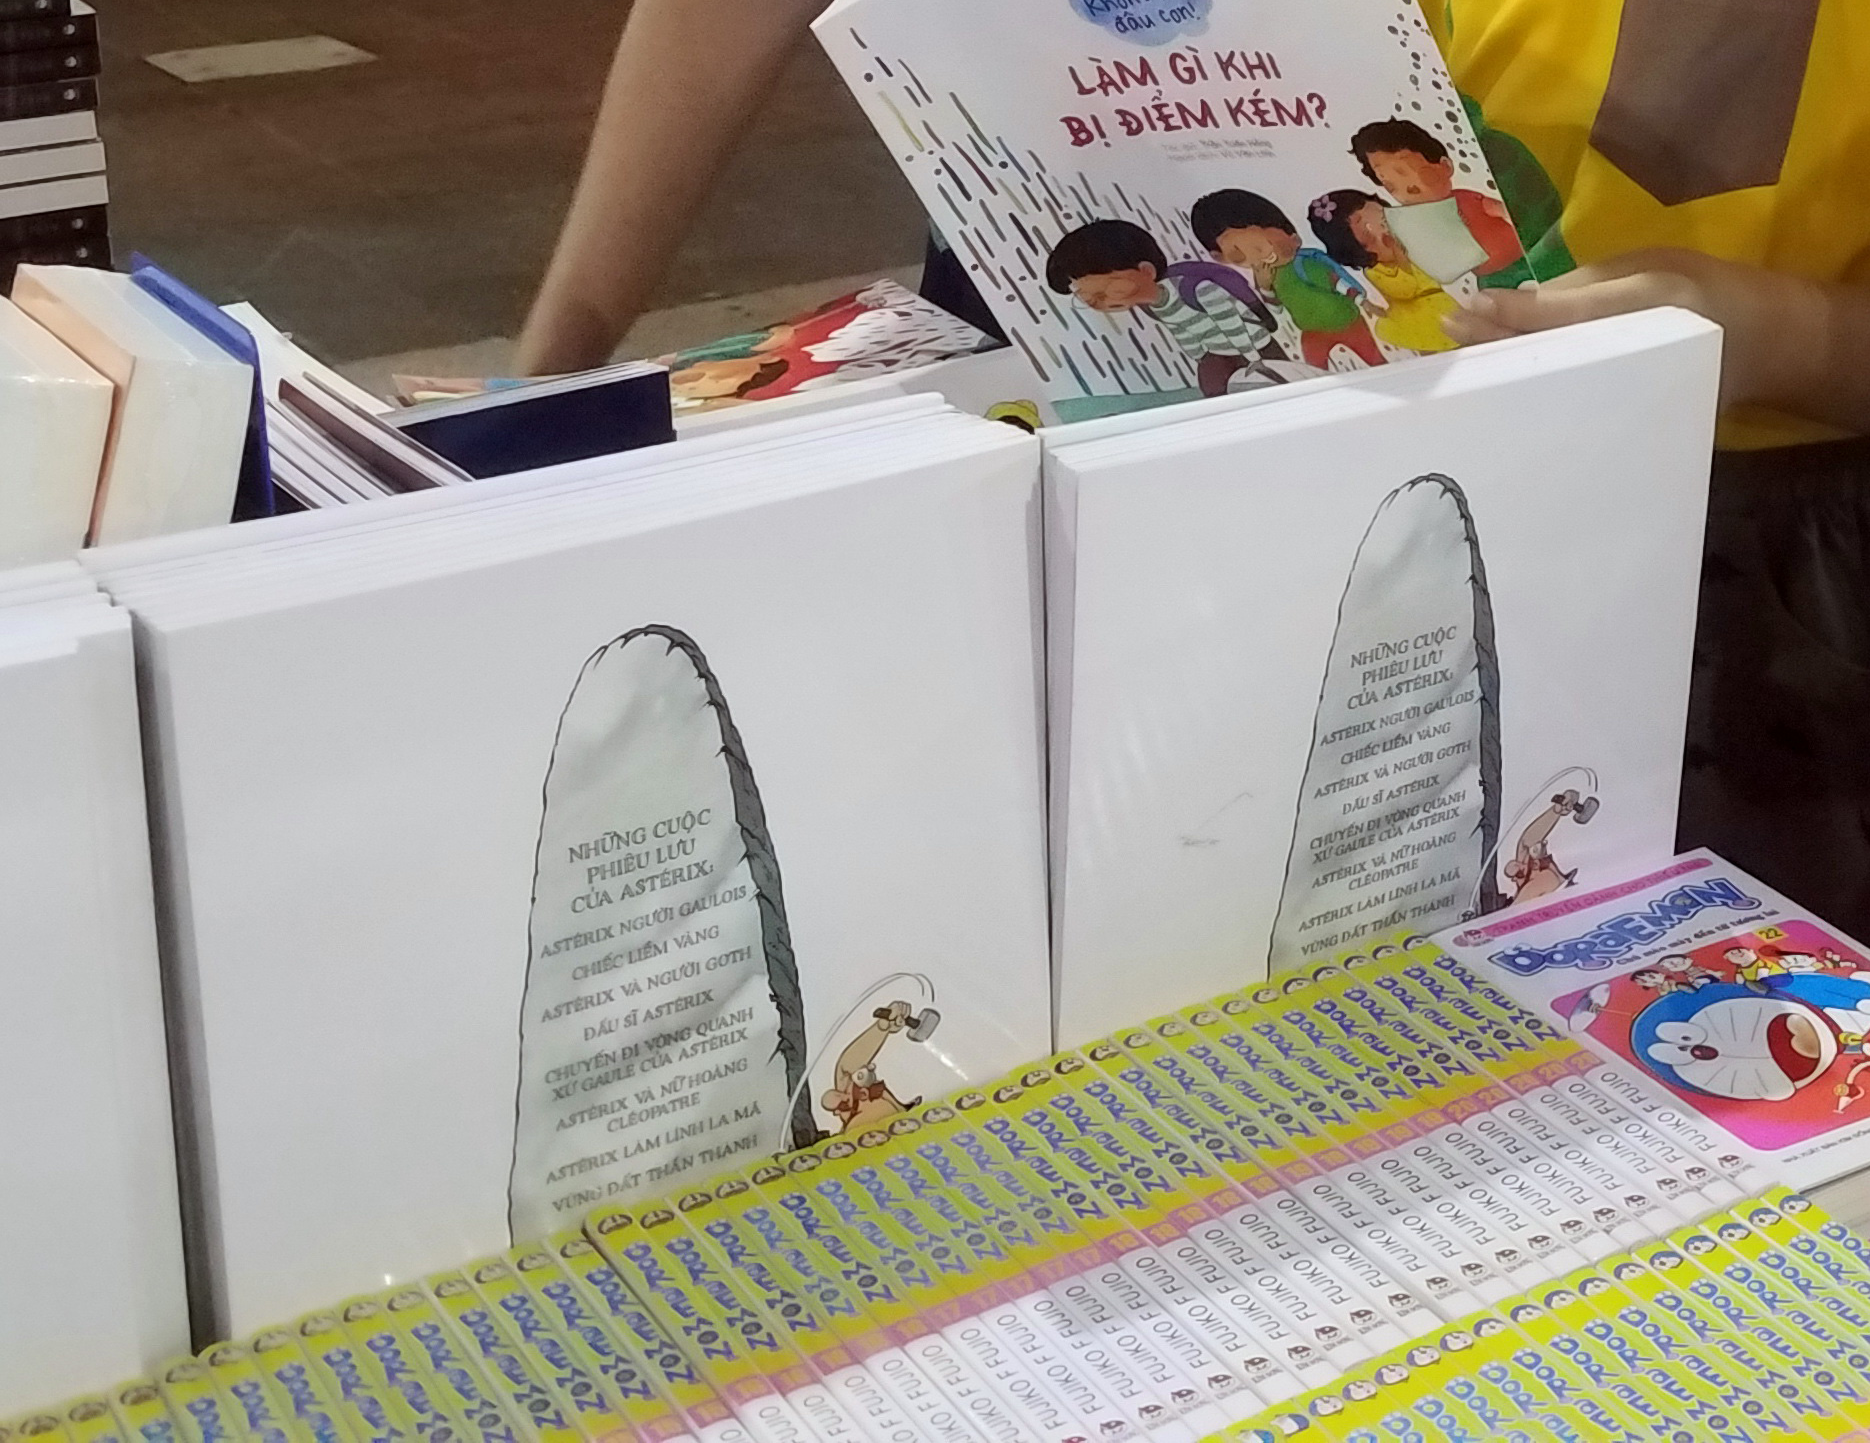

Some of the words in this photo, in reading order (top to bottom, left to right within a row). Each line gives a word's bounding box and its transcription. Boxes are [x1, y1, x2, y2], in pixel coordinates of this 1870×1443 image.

[1162, 1, 1202, 26] con!
[1069, 57, 1159, 97] LÀM
[1168, 46, 1211, 86] GÌ
[1215, 50, 1282, 83] KHI
[1060, 113, 1112, 149] BỊ
[1114, 90, 1217, 138] ĐIỂM
[1225, 88, 1331, 131] KÉM?
[1758, 927, 1784, 940] 22
[1568, 1083, 1615, 1115] FUJIO
[1600, 1072, 1648, 1104] FUJIO
[1508, 1108, 1555, 1141] FUJIO
[1540, 1093, 1588, 1125] FUJIO
[1625, 1123, 1684, 1164] FUJIKO
[1658, 1112, 1718, 1152] FUJIKO
[1564, 1149, 1624, 1191] FUJIKO
[1596, 1134, 1656, 1174] FUJIKO
[1135, 1256, 1184, 1295] FUJIO
[1188, 1305, 1248, 1353] FUJIKO
